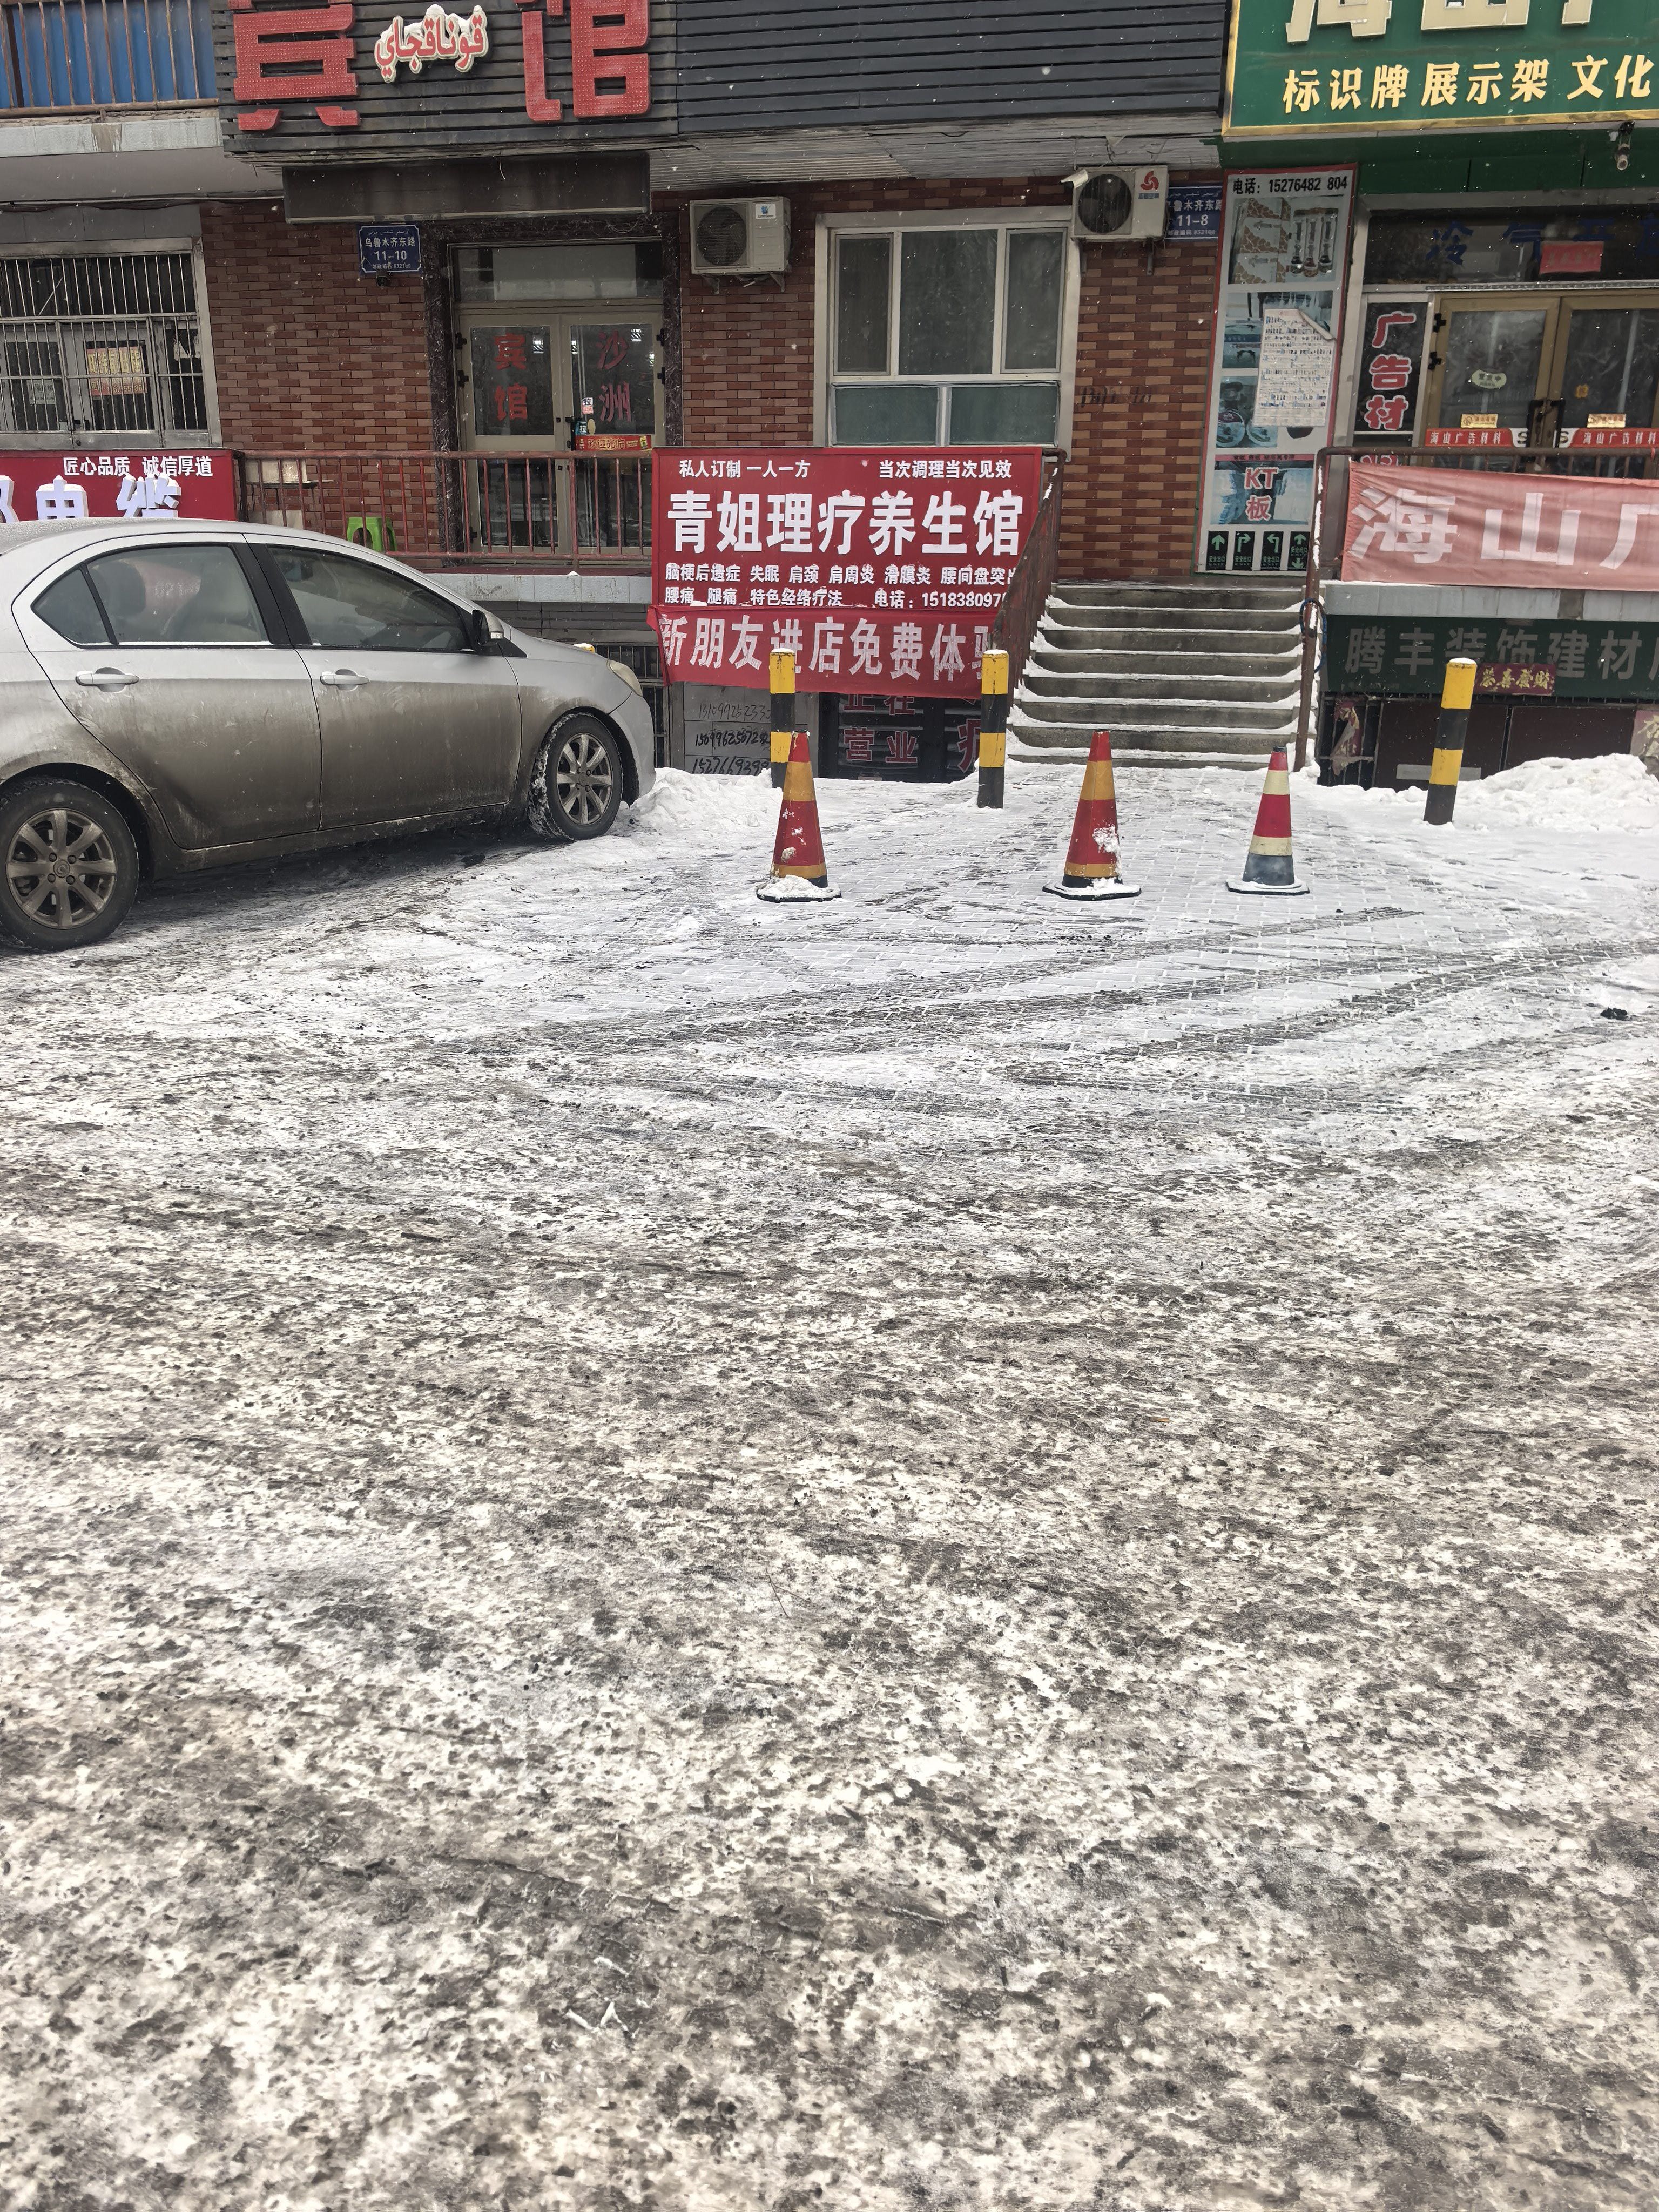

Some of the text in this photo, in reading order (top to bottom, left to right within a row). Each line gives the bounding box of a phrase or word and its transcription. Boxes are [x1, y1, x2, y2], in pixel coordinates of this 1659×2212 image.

[1282, 54, 1656, 114] 标识牌 展示架 文化
[1268, 177, 1321, 193] 15276482
[1327, 176, 1348, 190] 804
[1176, 214, 1209, 227] 11-8
[366, 237, 415, 247] 乌鲁木齐东路
[375, 251, 407, 260] 11-10
[494, 332, 528, 421] 宾馆
[597, 330, 631, 422] 沙洲
[587, 437, 626, 450] 欢迎光临
[63, 455, 213, 478] 匠心品质 诚信厚道
[679, 459, 1013, 480] 私人订制 一人一方 当次调理当次见效
[1244, 467, 1279, 490] KT
[1244, 494, 1273, 521] 板
[667, 489, 1023, 557] 青姐理疗养生馆
[665, 562, 741, 582] 脑梗后遗症
[750, 564, 780, 583] 失眠
[788, 564, 820, 584] 肩颈
[828, 564, 875, 585] 肩周炎
[884, 563, 932, 585] 滑膜炎
[664, 586, 695, 604] 腰痛
[707, 587, 738, 605] 腿痛
[750, 586, 843, 607] 特色经络疗法
[1344, 626, 1659, 680] 腾丰装饰建材
[843, 726, 918, 764] 营业
